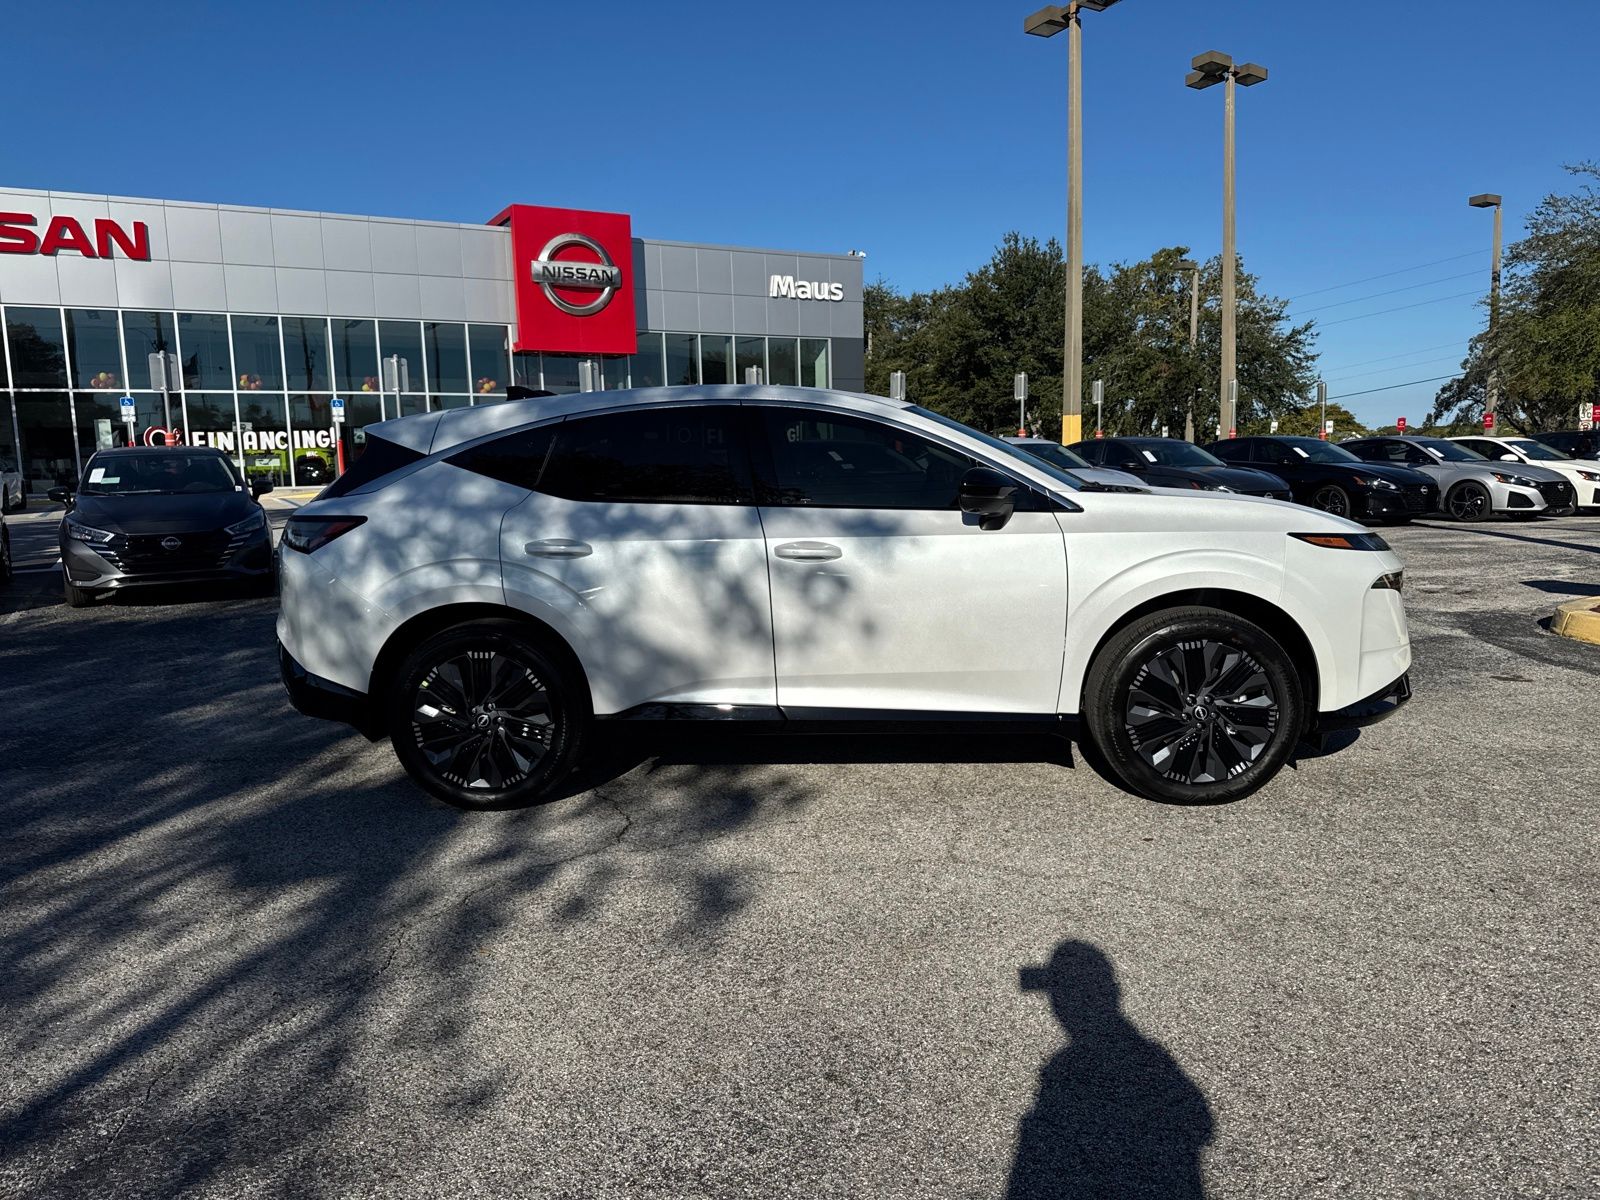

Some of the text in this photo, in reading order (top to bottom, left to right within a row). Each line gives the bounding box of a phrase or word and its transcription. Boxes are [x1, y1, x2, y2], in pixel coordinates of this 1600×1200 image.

[542, 265, 614, 282] NISSAN
[769, 275, 844, 301] Maus
[191, 427, 336, 451] FINANCING!
